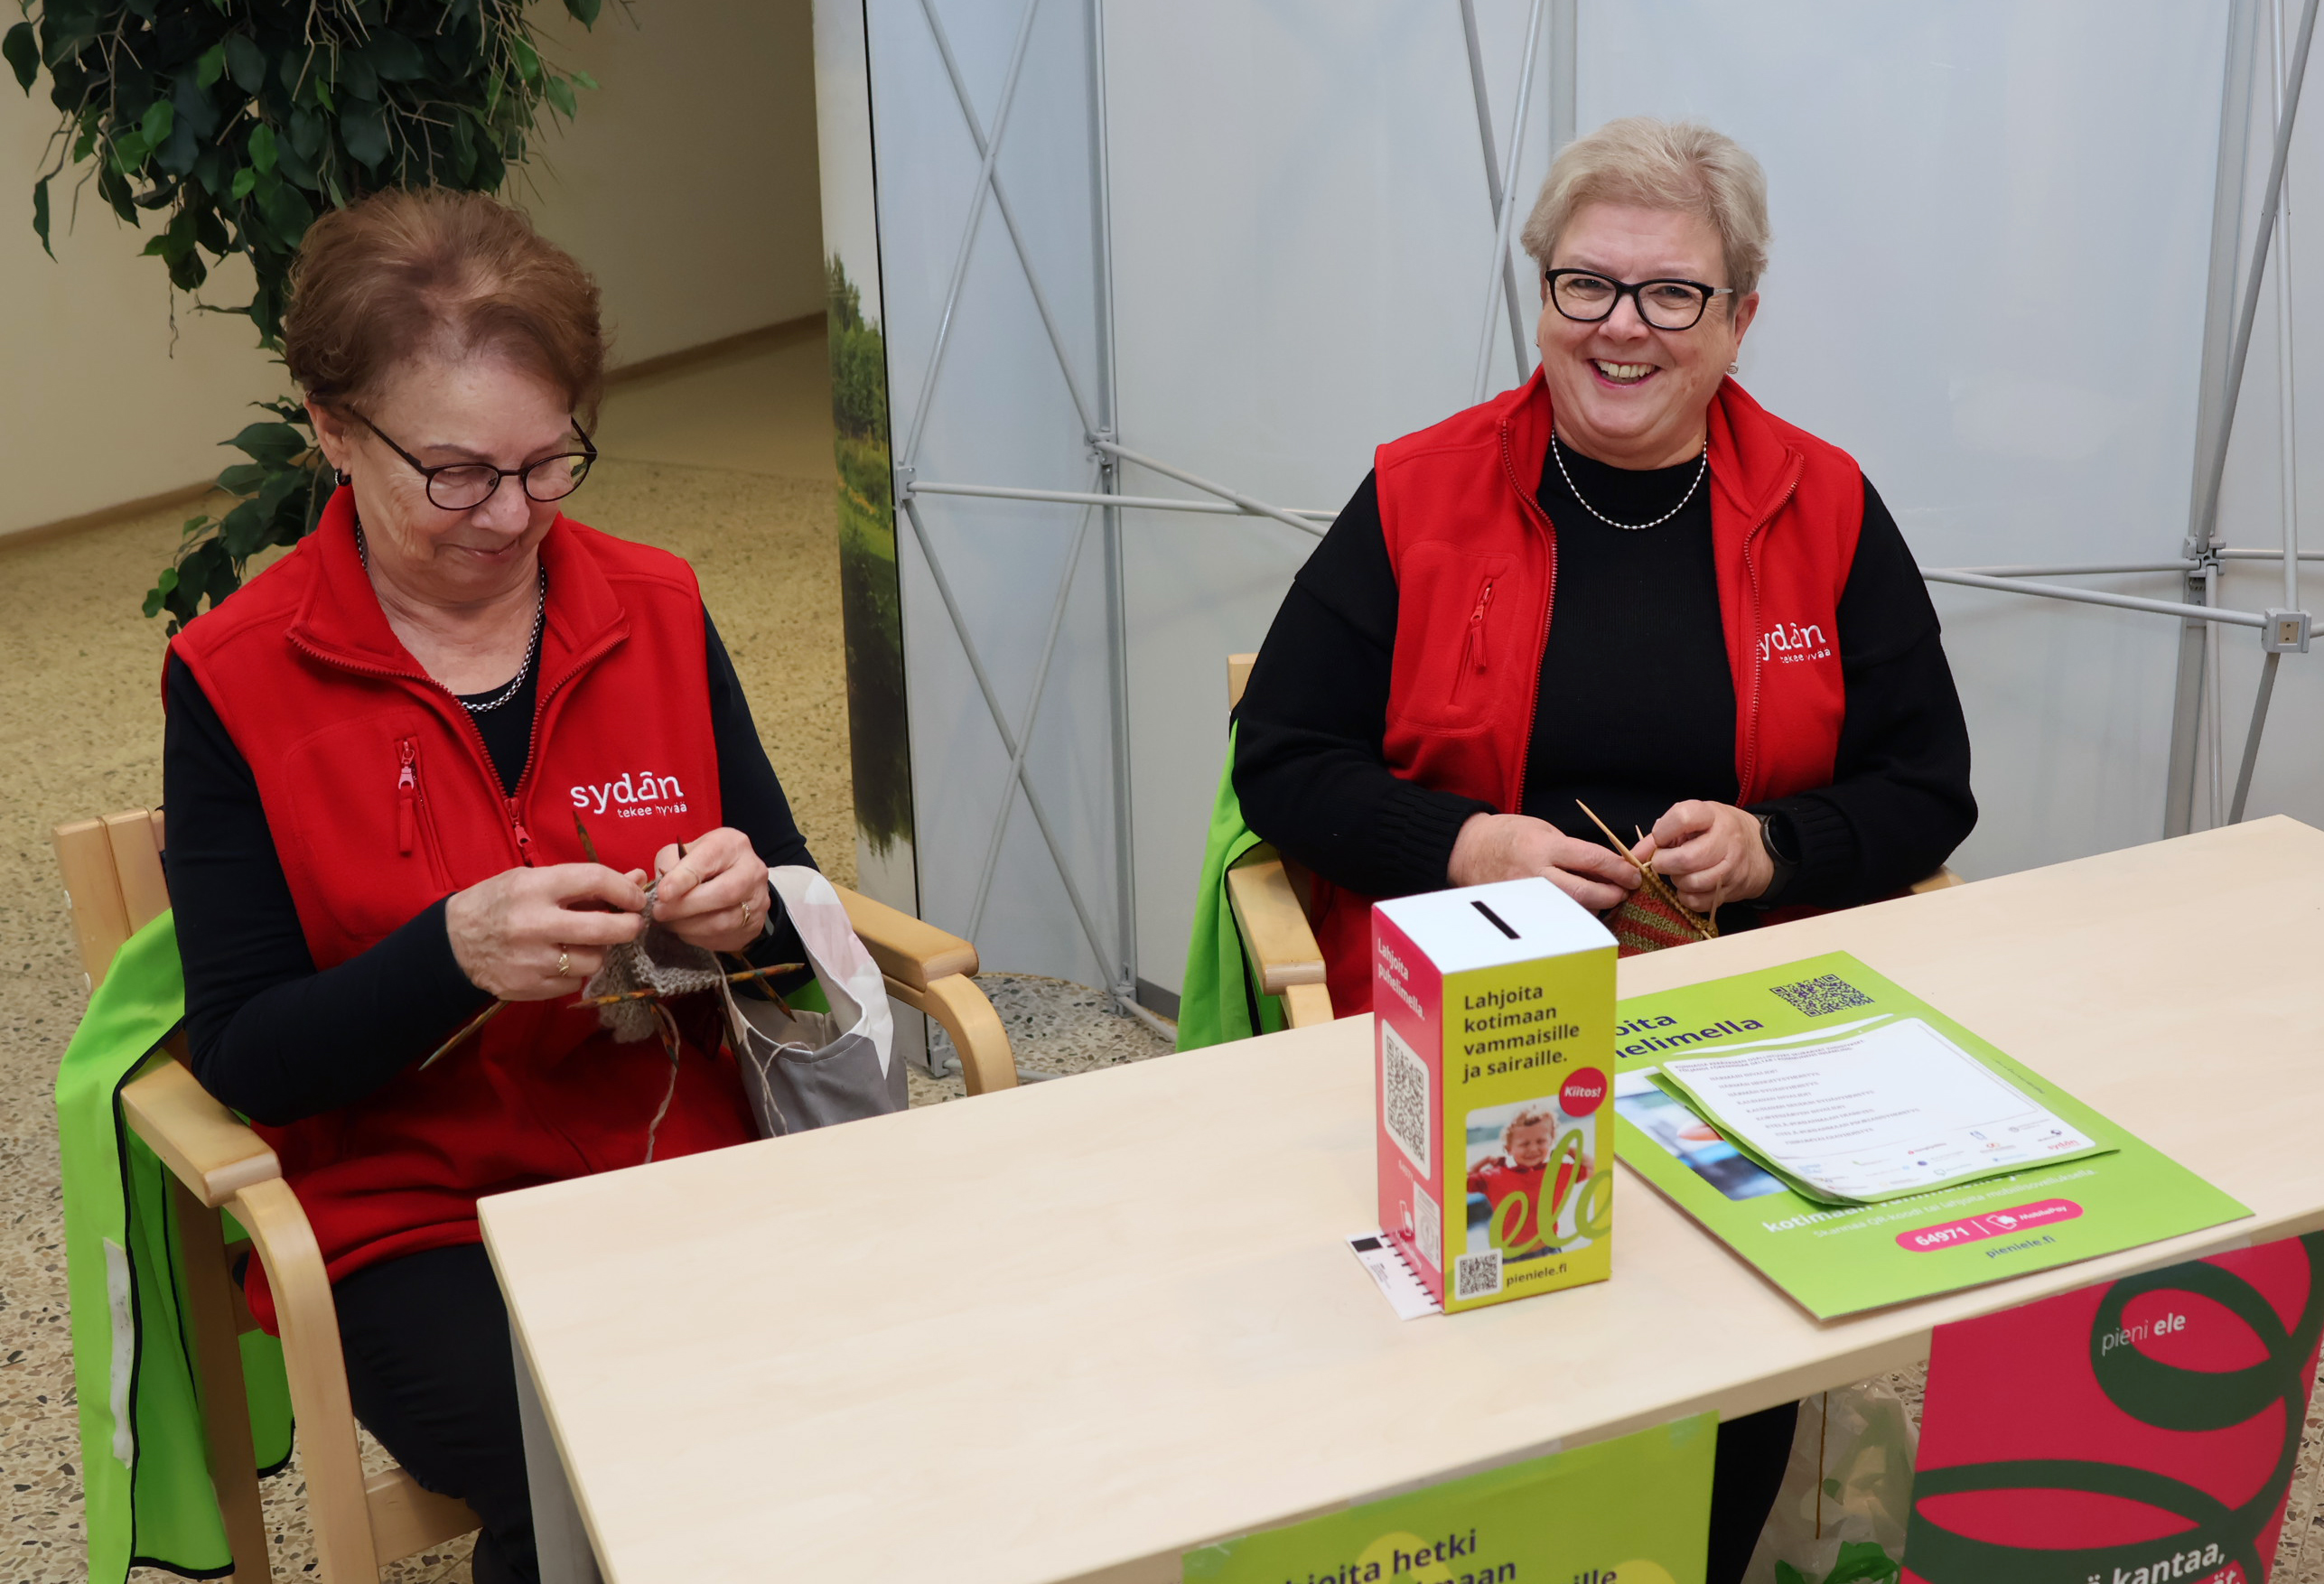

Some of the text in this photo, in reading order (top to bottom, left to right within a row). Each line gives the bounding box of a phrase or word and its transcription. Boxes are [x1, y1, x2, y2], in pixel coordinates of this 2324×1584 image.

[617, 806, 652, 818] tekee
[1377, 937, 1409, 982] Lahjoita
[1464, 985, 1544, 1011] Lahjoita
[1464, 1007, 1557, 1034] kotimaan
[1464, 1023, 1581, 1056] vammaisille
[1616, 1019, 1765, 1059] elimella
[1461, 1049, 1568, 1085] ja sairaille.
[1563, 1086, 1602, 1098] Kiitos!
[1915, 1225, 1971, 1246] 64971
[1985, 1235, 2057, 1260] pieniele.fi
[1506, 1263, 1567, 1288] pieniele.fi
[2101, 1312, 2187, 1357] pieni ele
[1393, 1528, 1477, 1575] hetki
